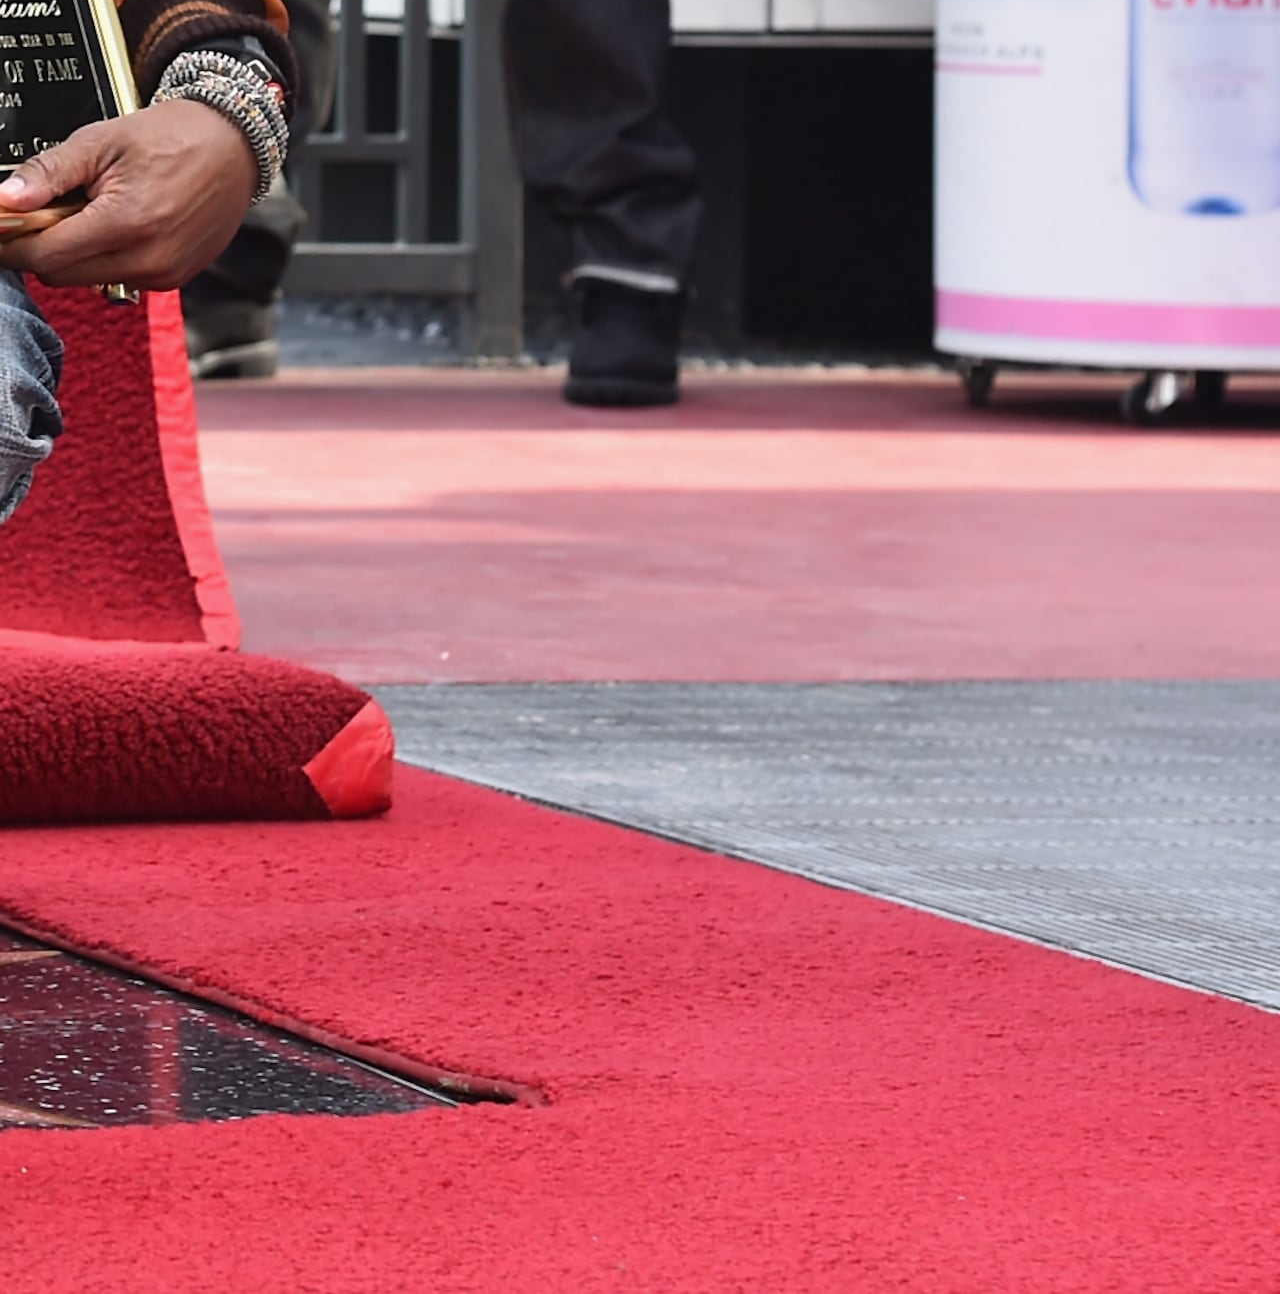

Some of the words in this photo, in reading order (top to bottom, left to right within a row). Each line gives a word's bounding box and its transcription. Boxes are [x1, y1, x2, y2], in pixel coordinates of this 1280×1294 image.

[58, 32, 75, 46] THE
[4, 59, 25, 84] OF
[34, 57, 84, 83] FAME
